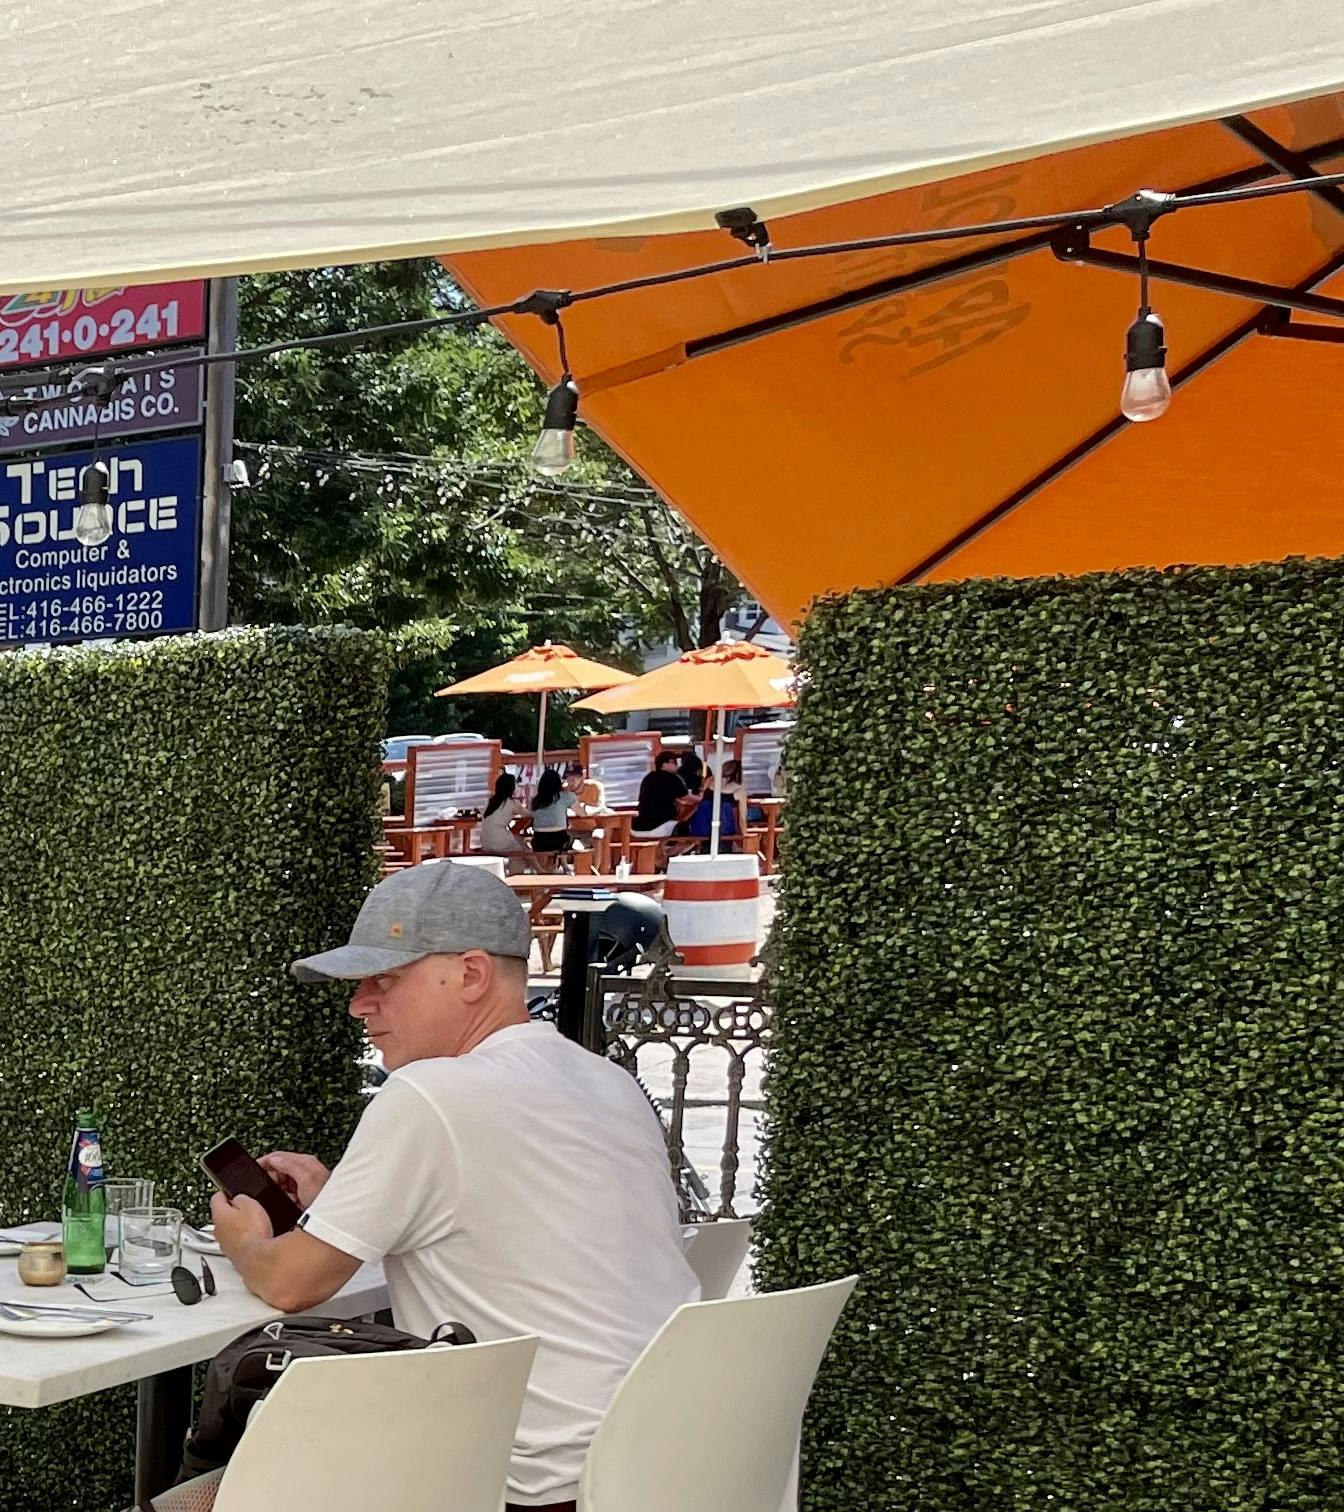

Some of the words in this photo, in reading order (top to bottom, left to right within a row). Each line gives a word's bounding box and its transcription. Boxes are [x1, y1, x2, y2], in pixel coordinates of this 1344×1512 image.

[23, 397, 135, 434] CANNABIS
[140, 391, 180, 418] CO.
[15, 545, 108, 570] Computer
[116, 539, 131, 559] &
[76, 564, 178, 592] liquidators
